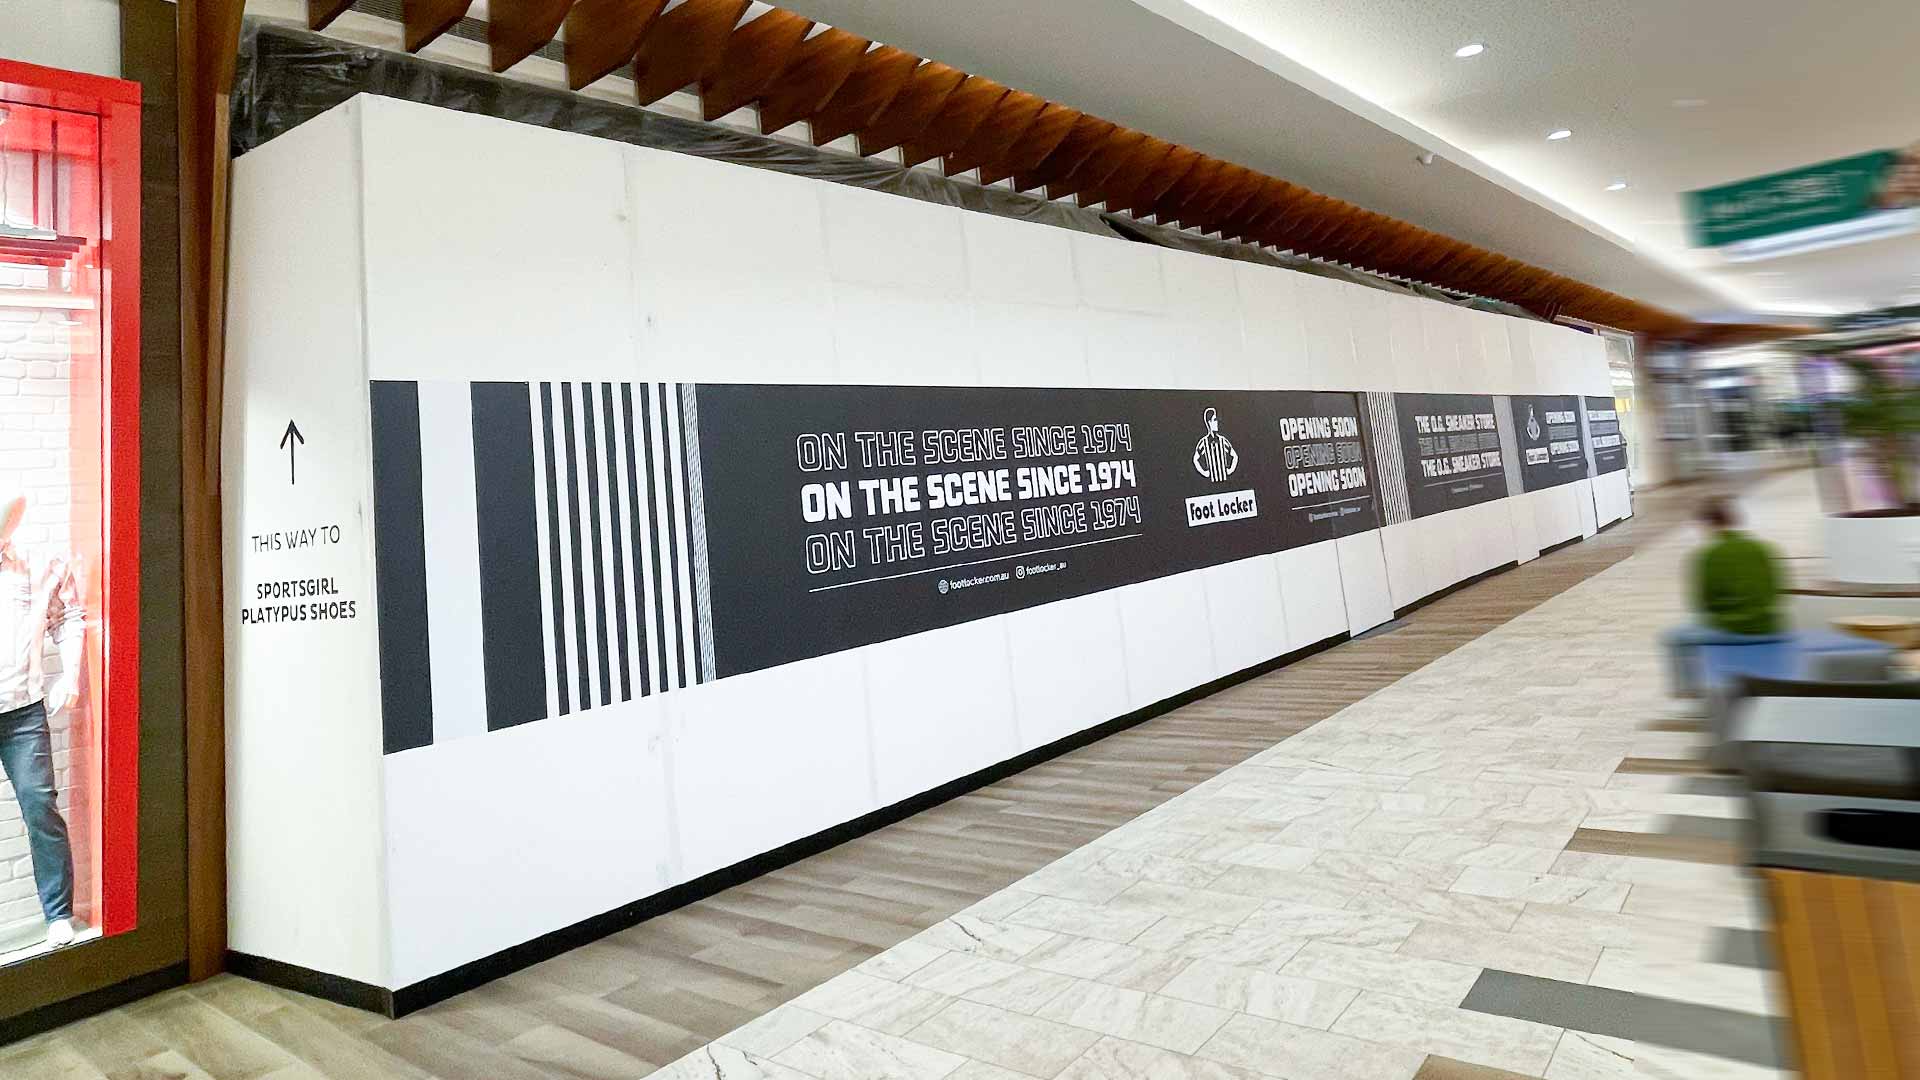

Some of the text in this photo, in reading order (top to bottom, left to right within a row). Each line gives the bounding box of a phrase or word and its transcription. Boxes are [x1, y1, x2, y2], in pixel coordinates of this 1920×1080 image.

[1279, 416, 1359, 441] OPENING SOON
[1414, 415, 1431, 434] THE
[1445, 414, 1476, 432] SNEAKER
[1474, 413, 1496, 430] STORE
[796, 423, 1132, 472] ON THE SCENE SINCE 1974
[1284, 442, 1335, 470] OPENING
[1420, 459, 1438, 478] THE
[1451, 453, 1482, 474] SNEAKER
[1480, 451, 1502, 469] STORE
[800, 459, 1136, 523] ON THE SCENE SINCE 1974
[1288, 466, 1367, 498] OPENING SOON
[1189, 496, 1253, 521] Foot Locker
[251, 525, 340, 553] THIS WAY TO
[805, 496, 1142, 574] ON THE SCENE SINCE 1974
[256, 576, 339, 600] SPORTSGIRL
[241, 600, 357, 625] PLATYPUS SHOES
